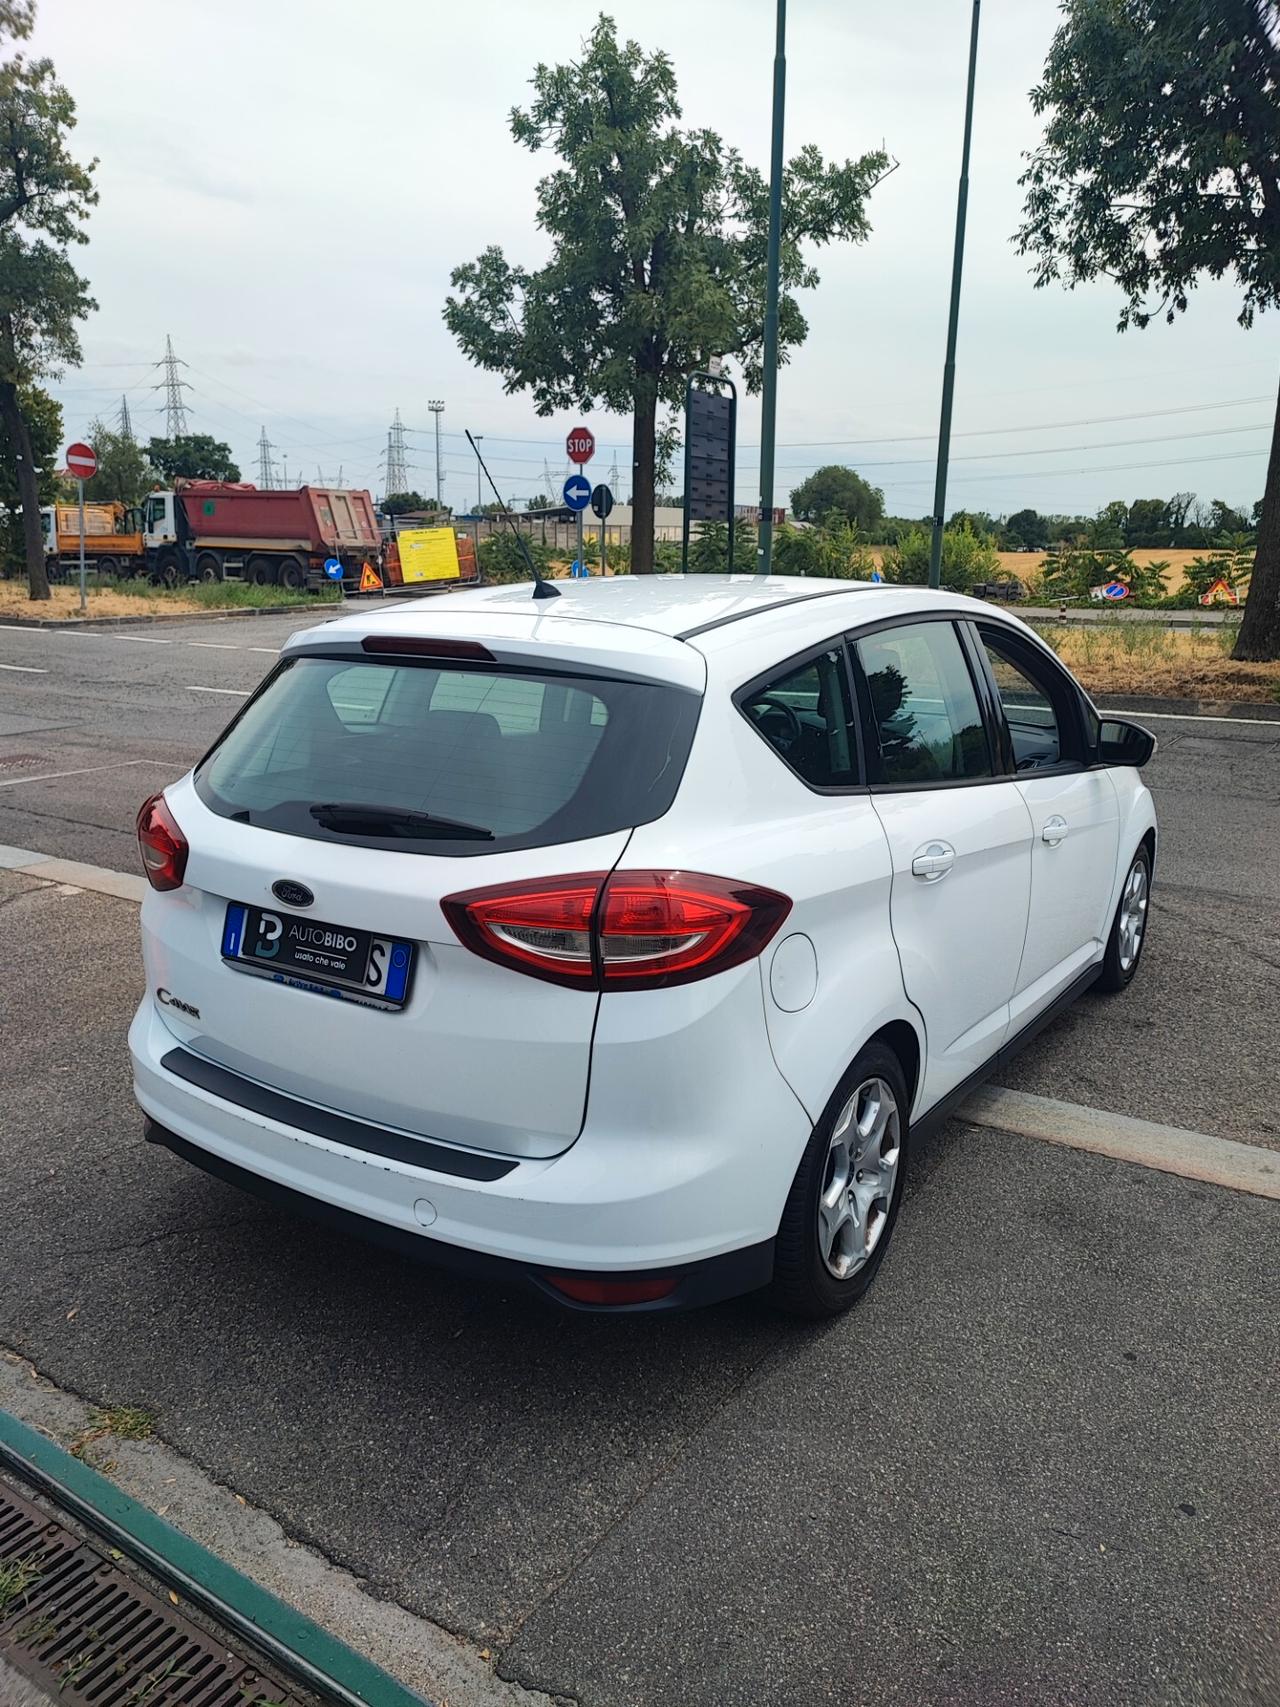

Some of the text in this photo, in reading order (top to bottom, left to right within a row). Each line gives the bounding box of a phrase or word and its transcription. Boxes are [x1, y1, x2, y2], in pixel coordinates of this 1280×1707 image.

[568, 438, 592, 453] STOP
[288, 924, 357, 952] AUTOBIBO
[294, 951, 346, 970] usato che vale
[366, 943, 386, 987] S
